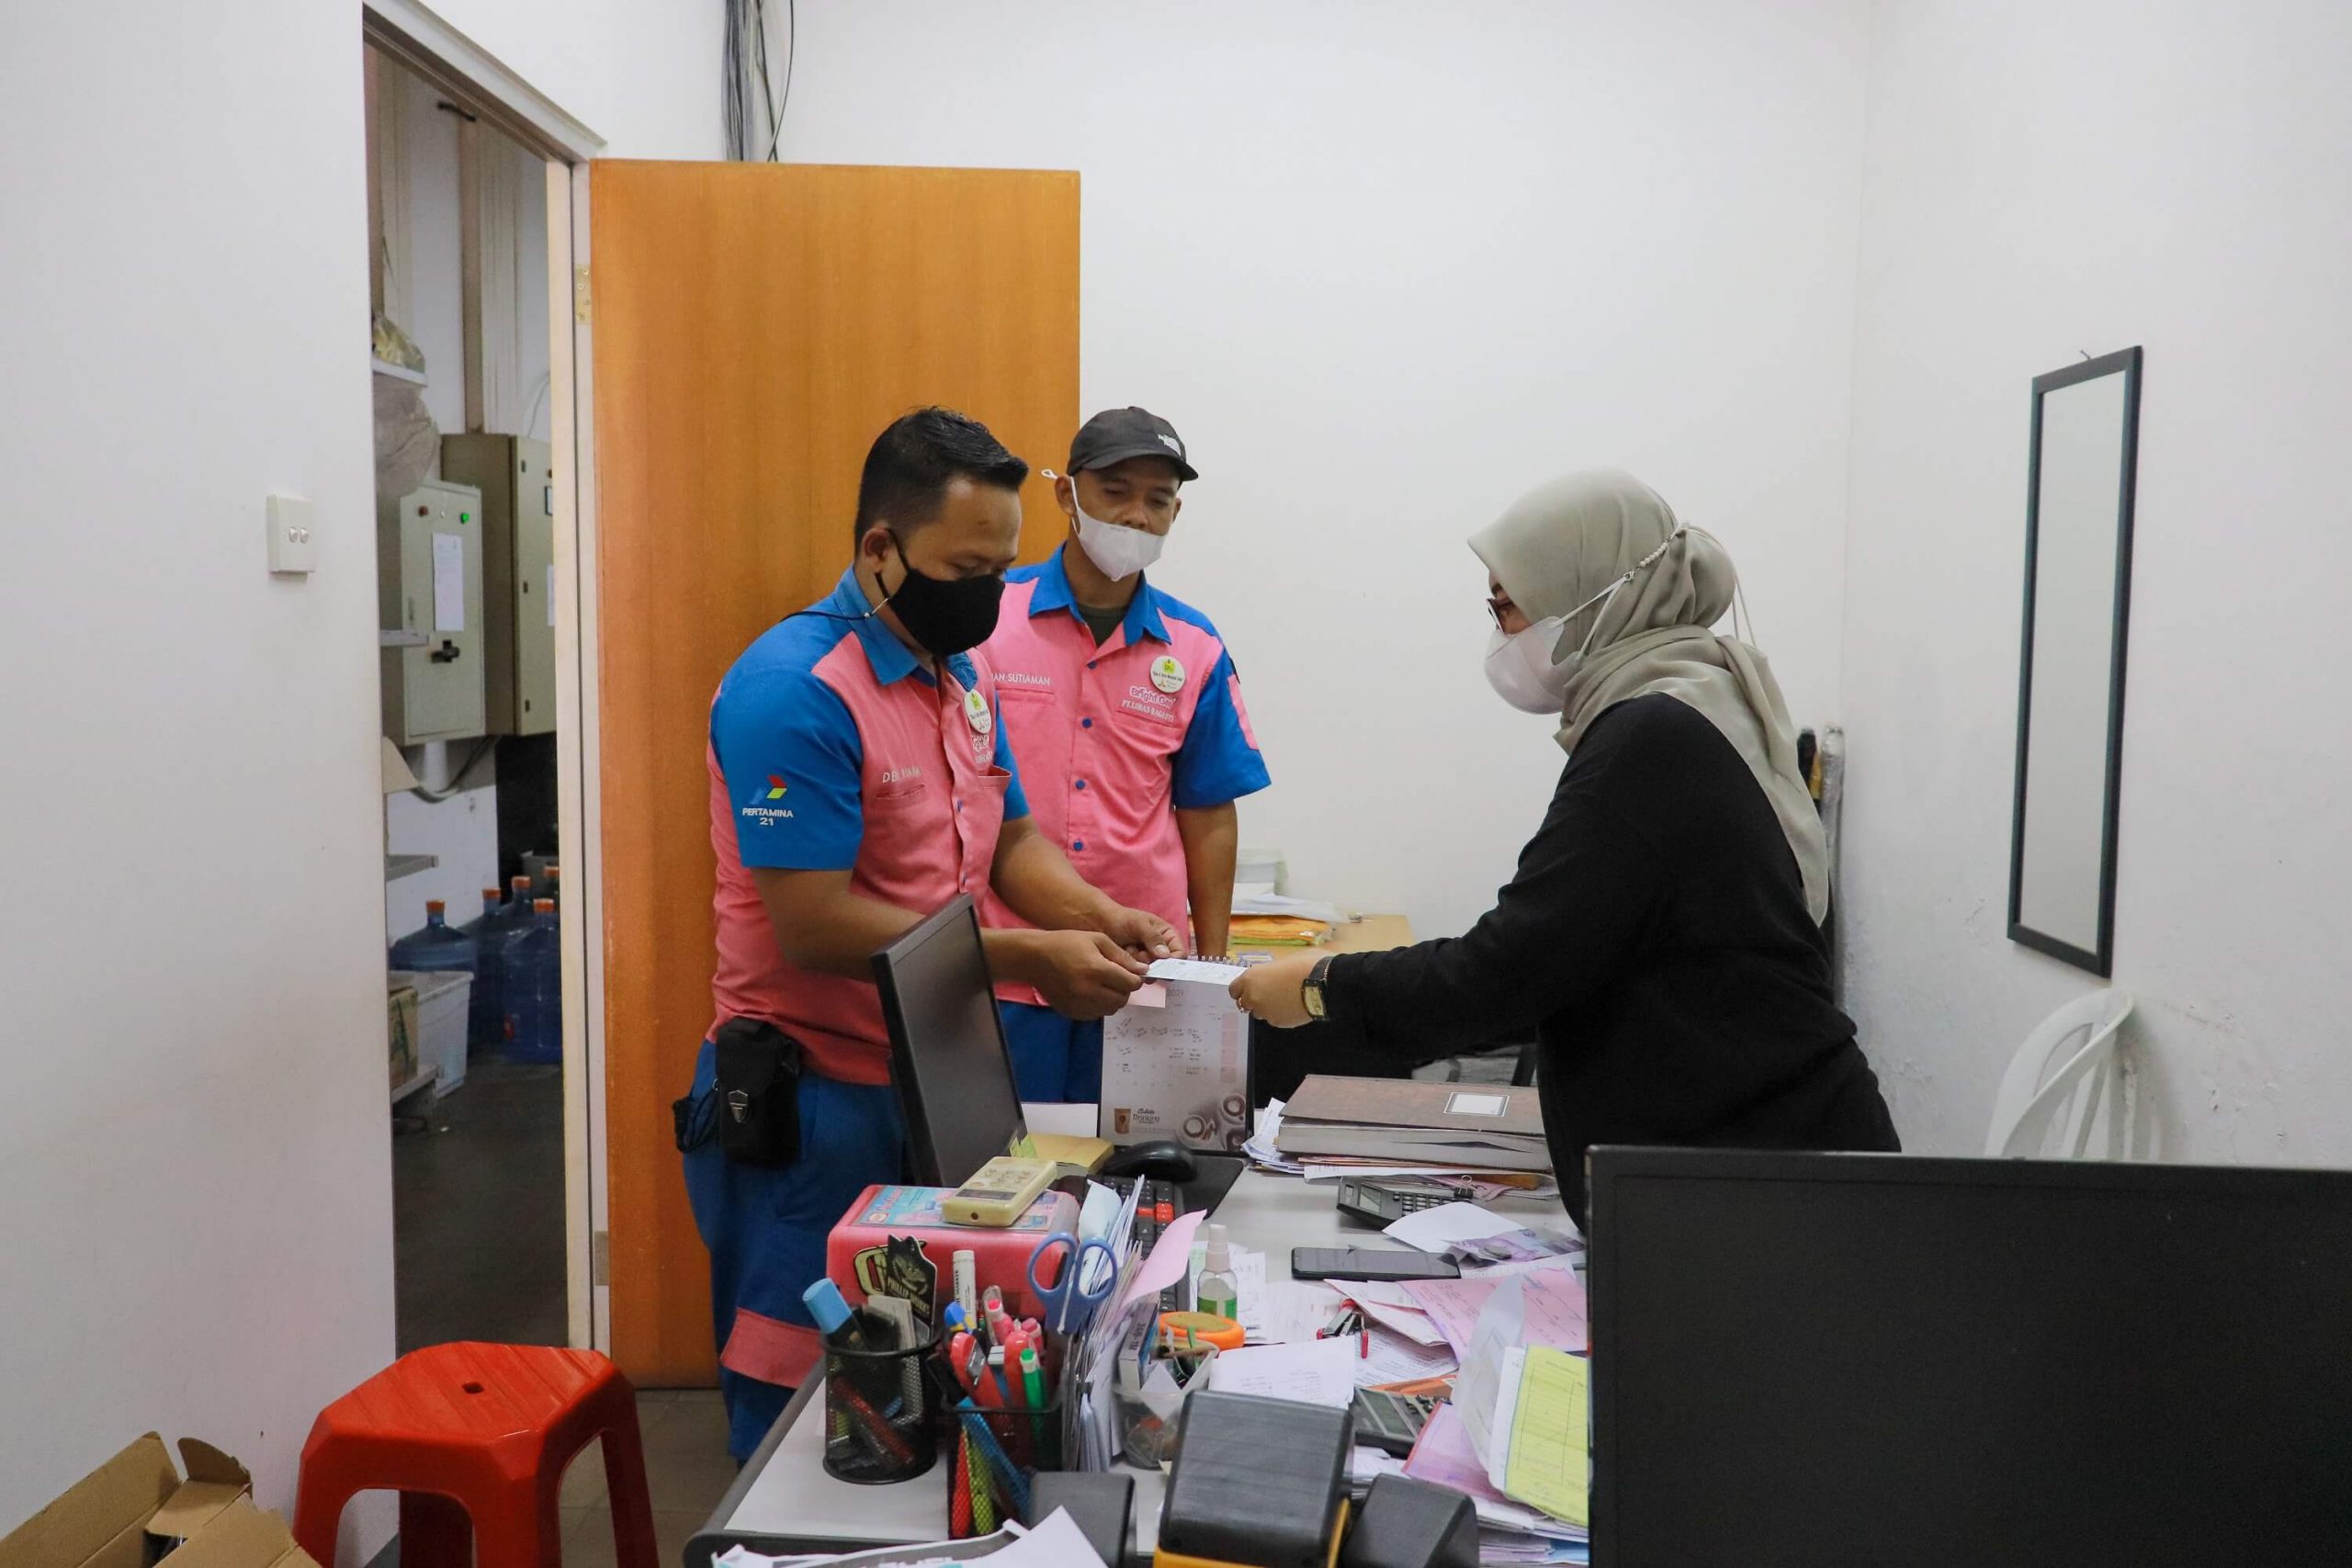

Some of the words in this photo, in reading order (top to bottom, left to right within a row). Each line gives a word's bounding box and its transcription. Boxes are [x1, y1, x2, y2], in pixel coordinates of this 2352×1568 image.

[992, 672, 1005, 682] AN
[1008, 673, 1050, 685] SUTIAMAN
[1130, 686, 1159, 703] Bright
[742, 808, 793, 818] PERTAMINA
[760, 818, 774, 826] 21
